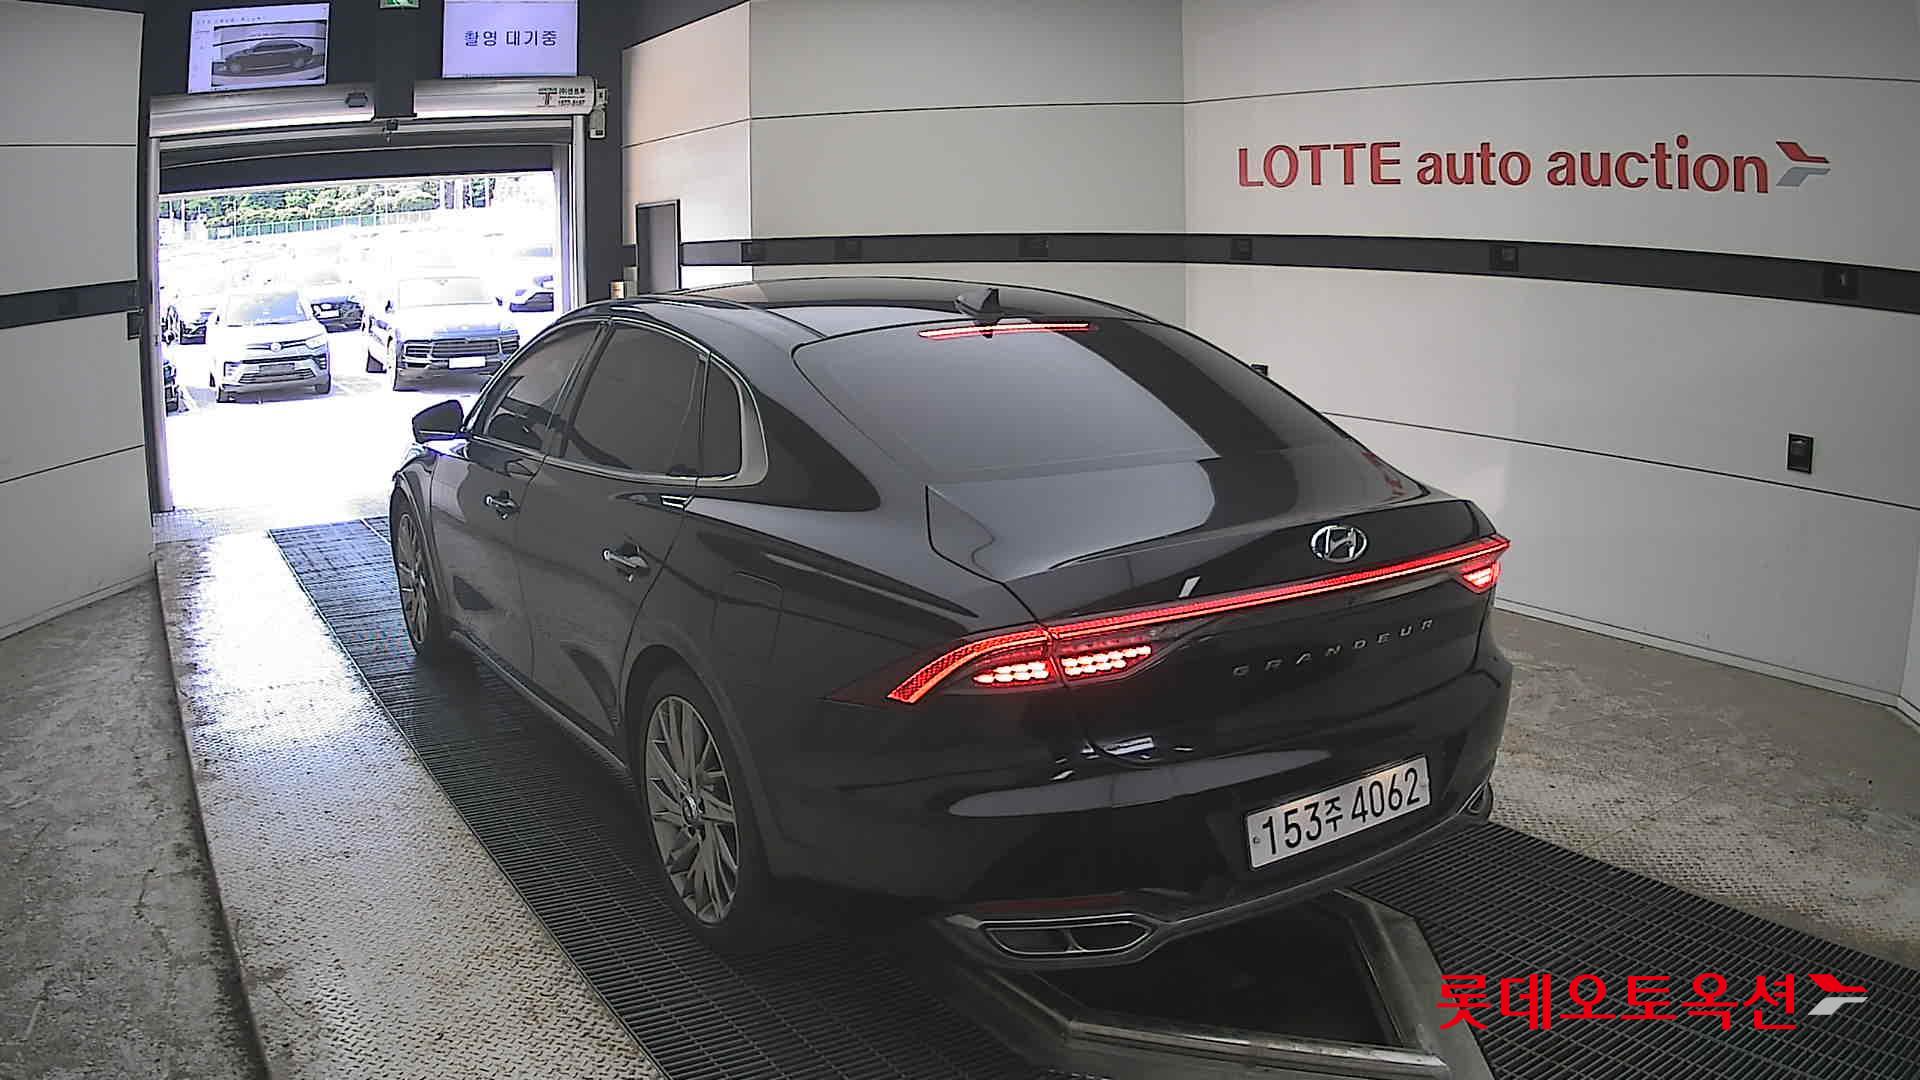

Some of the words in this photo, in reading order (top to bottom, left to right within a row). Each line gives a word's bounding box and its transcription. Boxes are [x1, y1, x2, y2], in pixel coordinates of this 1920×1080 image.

[505, 30, 558, 47] 대기중
[1237, 141, 1401, 188] LOTTE
[1416, 142, 1531, 187] auto
[1546, 135, 1769, 194] auction
[1232, 618, 1434, 677] GRANDEUR
